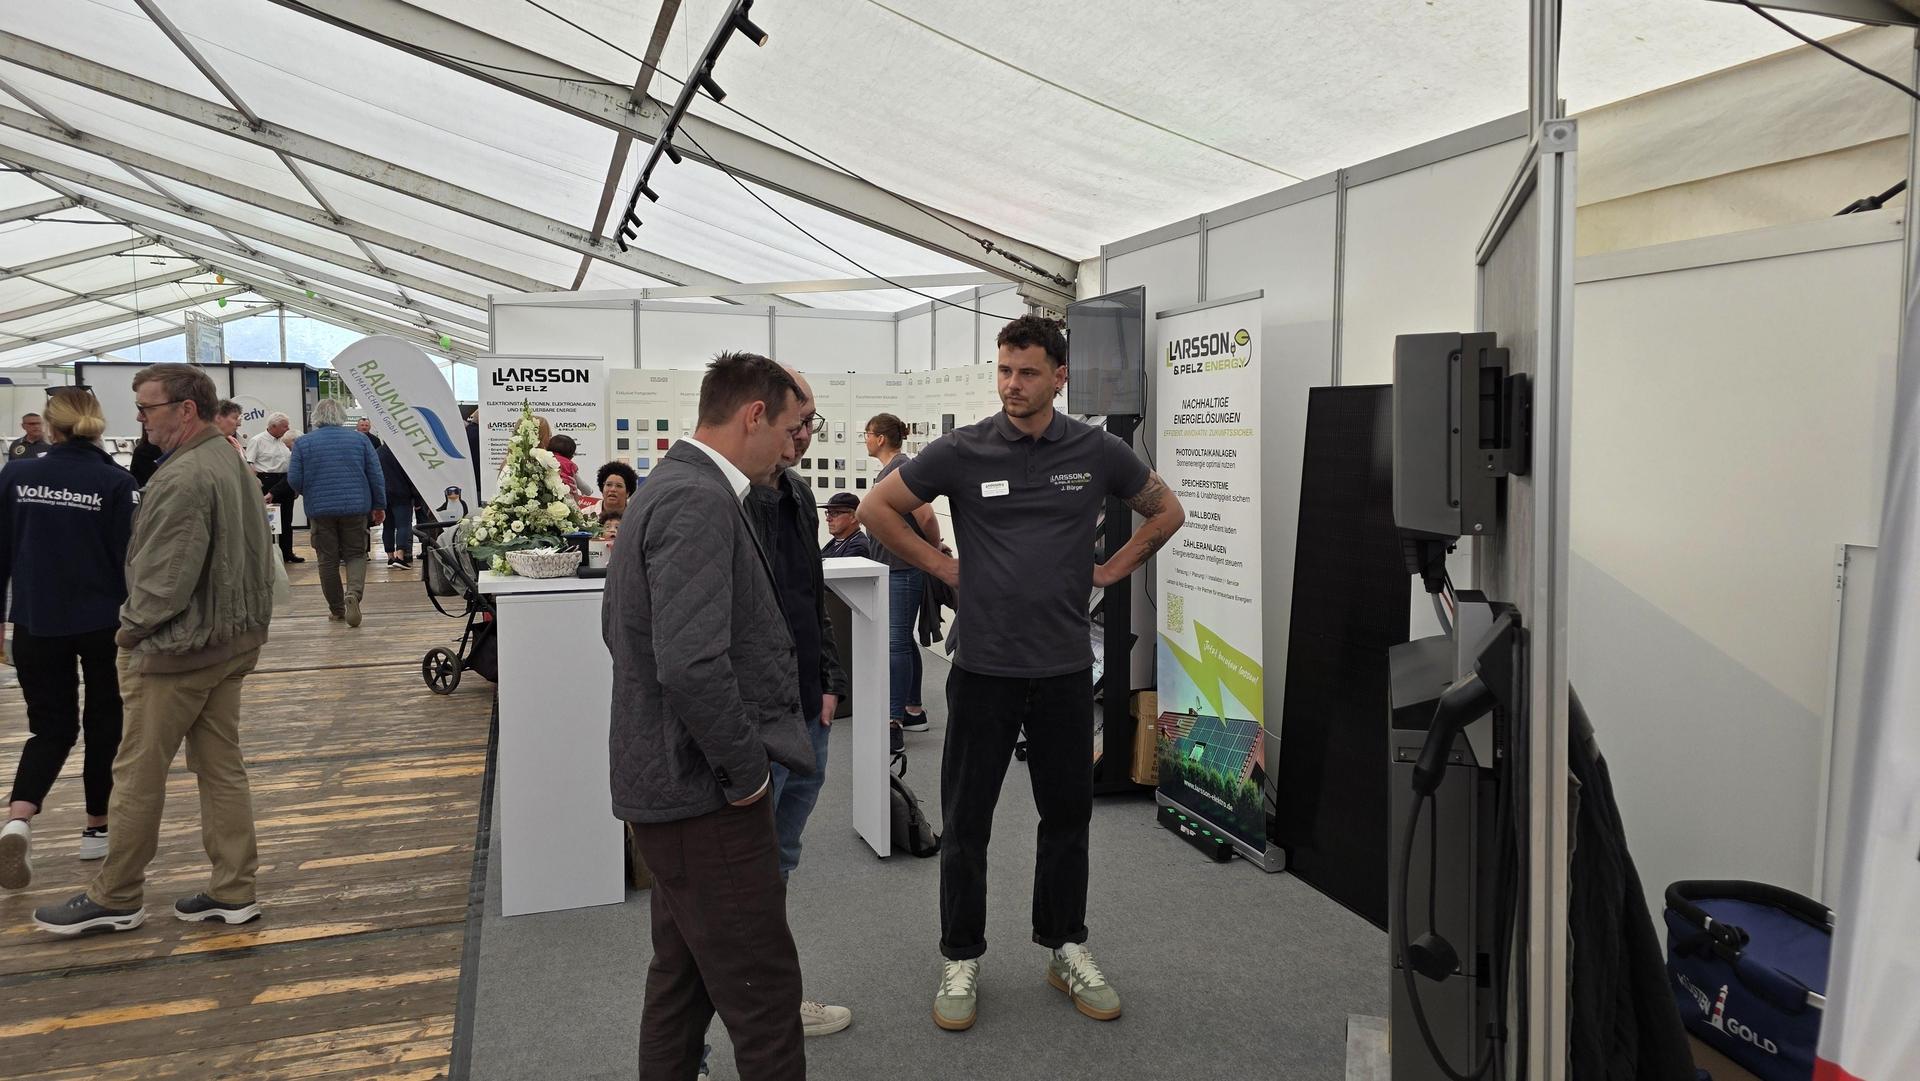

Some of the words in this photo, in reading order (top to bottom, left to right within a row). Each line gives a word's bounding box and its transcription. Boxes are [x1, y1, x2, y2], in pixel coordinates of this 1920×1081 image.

[1167, 332, 1229, 367] LARSSON
[1173, 366, 1180, 375] &
[1180, 363, 1203, 374] PELZ
[1204, 358, 1246, 372] ENERGY
[492, 368, 589, 386] LARSSON
[350, 368, 385, 416] KLIMATECHNIK
[383, 416, 399, 435] GmbH
[1182, 397, 1229, 409] NACHHALTIGE
[1173, 411, 1240, 425] ENERGIELÖSUNGEN
[1175, 449, 1237, 457] PHOTOVOLTAIKANLAGEN
[1176, 459, 1206, 469] Sonnenenergie
[1206, 461, 1221, 469] optimal
[1221, 461, 1236, 469] nutzen
[1050, 473, 1083, 482] LARSSON
[1181, 479, 1229, 490] SPEICHERSYSTEME
[16, 485, 103, 506] Volksbank
[1177, 490, 1196, 498] speichern
[1232, 494, 1251, 502] sichern
[1189, 510, 1221, 521] WALLBOXEN
[1224, 526, 1237, 534] laden
[1183, 539, 1227, 554] ZÄHLERANLAGEN
[1172, 547, 1206, 561] Energieverbrauch
[1205, 553, 1225, 566] intelligent
[1224, 559, 1243, 568] steuern
[1203, 640, 1218, 657] Jetzt
[1183, 779, 1234, 812] www.larsson-elektro.de
[1726, 1017, 1778, 1055] GOLD
